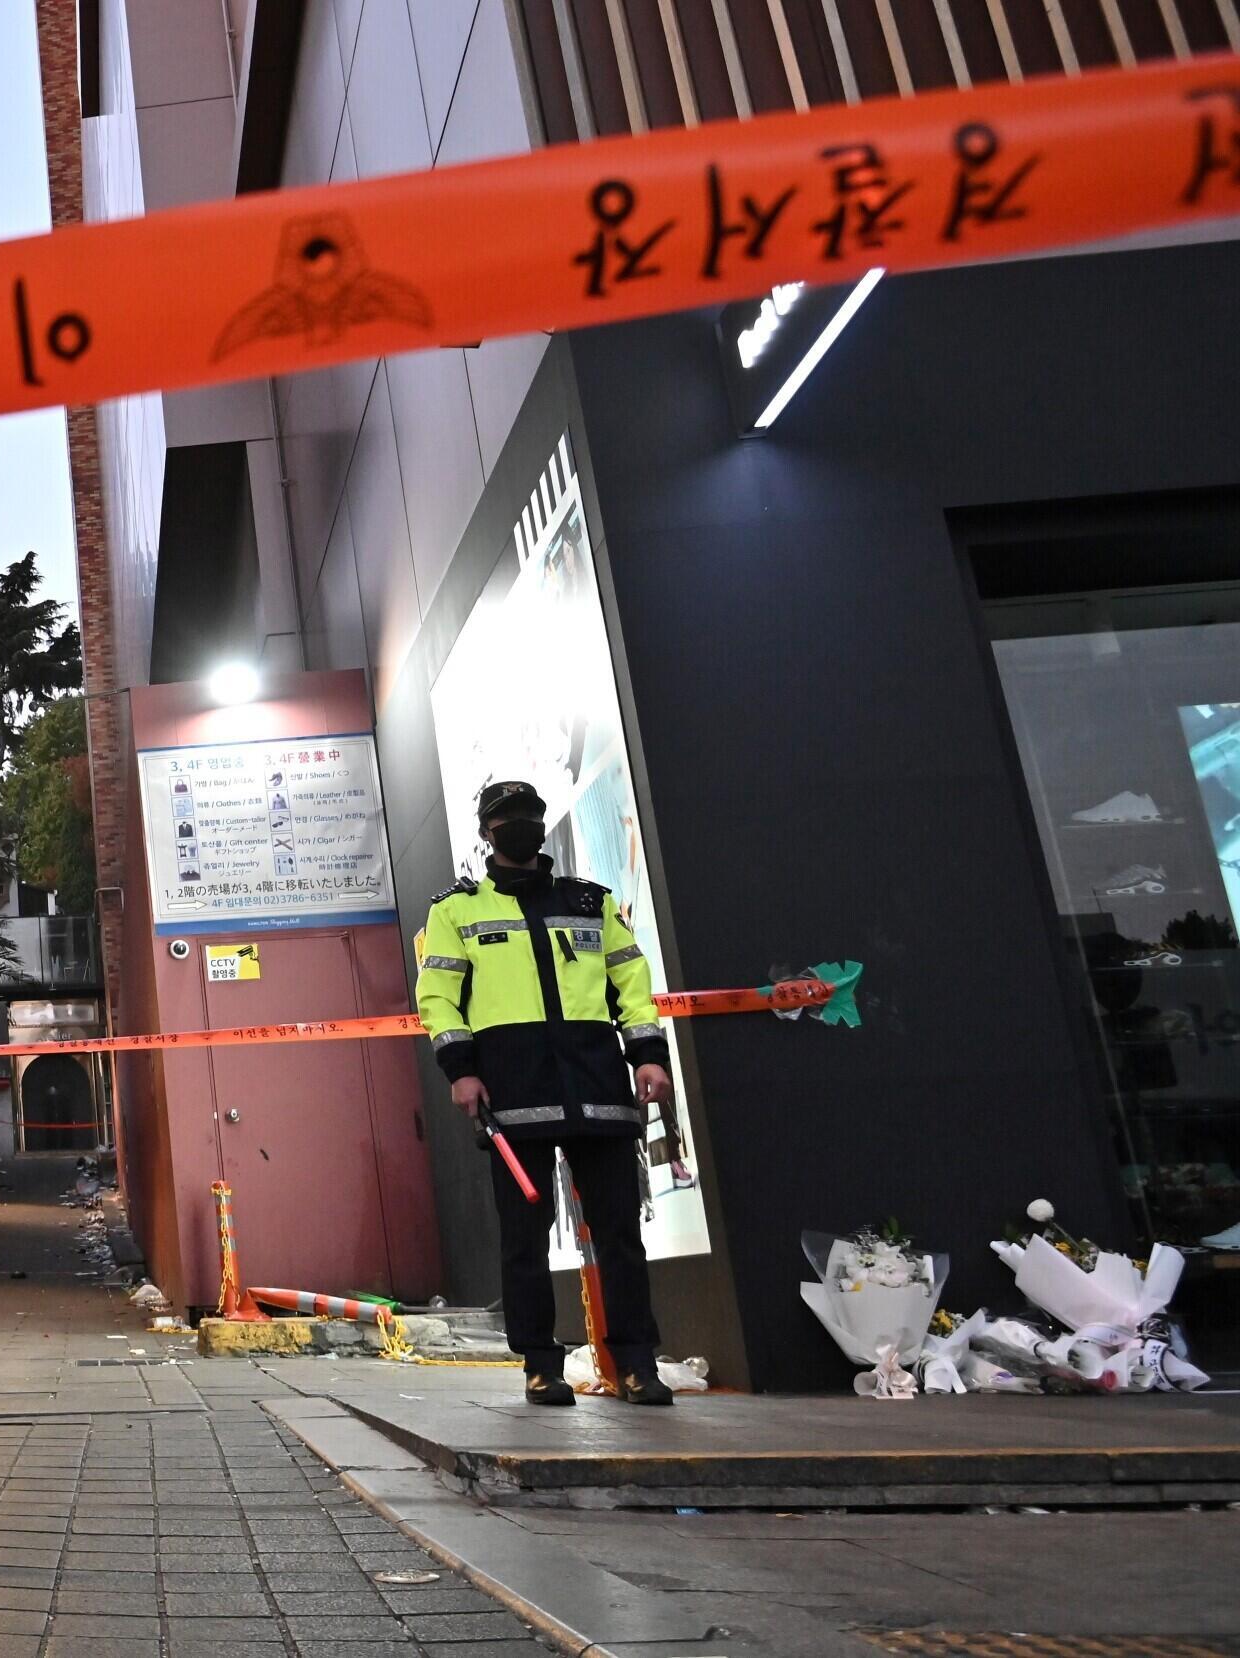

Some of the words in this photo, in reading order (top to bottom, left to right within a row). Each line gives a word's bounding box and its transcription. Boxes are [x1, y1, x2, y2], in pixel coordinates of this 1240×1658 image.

[572, 121, 1043, 297] 경찰서장
[319, 789, 341, 799] Leather
[229, 838, 243, 847] Gift
[244, 838, 268, 846] center
[317, 835, 336, 845] Cigar
[231, 860, 260, 870] Jewelry
[211, 898, 224, 907] 4F
[225, 895, 262, 908] 임대문의
[263, 891, 334, 905] 02)3786-6351
[575, 942, 601, 950] POLICE
[210, 958, 236, 967] CCTV
[232, 1028, 271, 1040] 이선을
